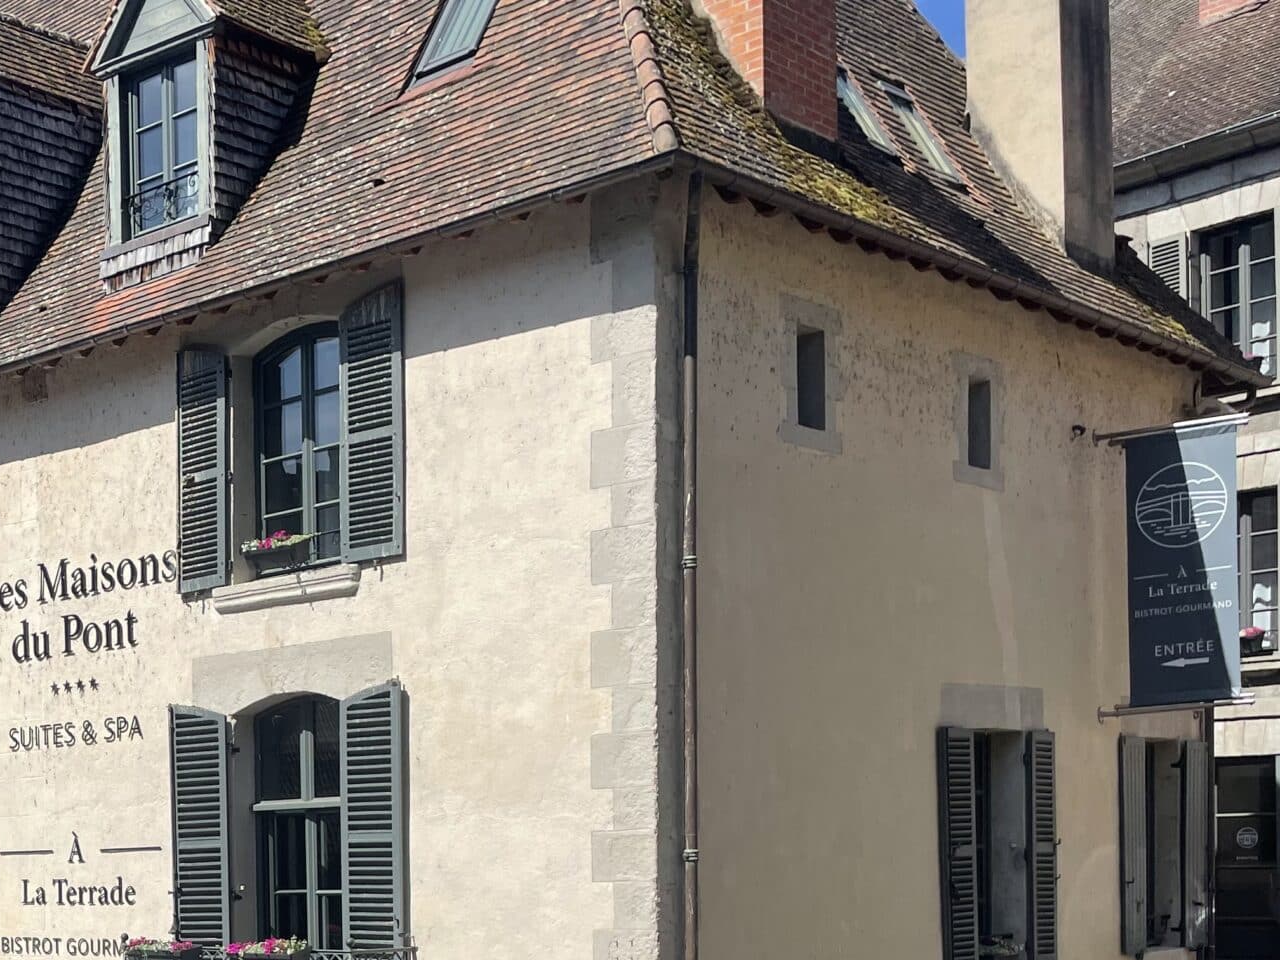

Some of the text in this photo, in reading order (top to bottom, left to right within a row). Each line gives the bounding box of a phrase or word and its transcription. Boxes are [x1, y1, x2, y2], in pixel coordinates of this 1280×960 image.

[36, 549, 177, 605] Maisons
[1148, 579, 1218, 598] La Terrade
[1134, 599, 1232, 618] BISTROT GOURMAND
[12, 609, 139, 664] du Pont
[1154, 639, 1215, 657] ENTRÉE
[8, 715, 144, 752] SUITES & SPA
[67, 831, 85, 863] À
[21, 876, 137, 906] La Terrade
[1, 937, 62, 955] BISTROT
